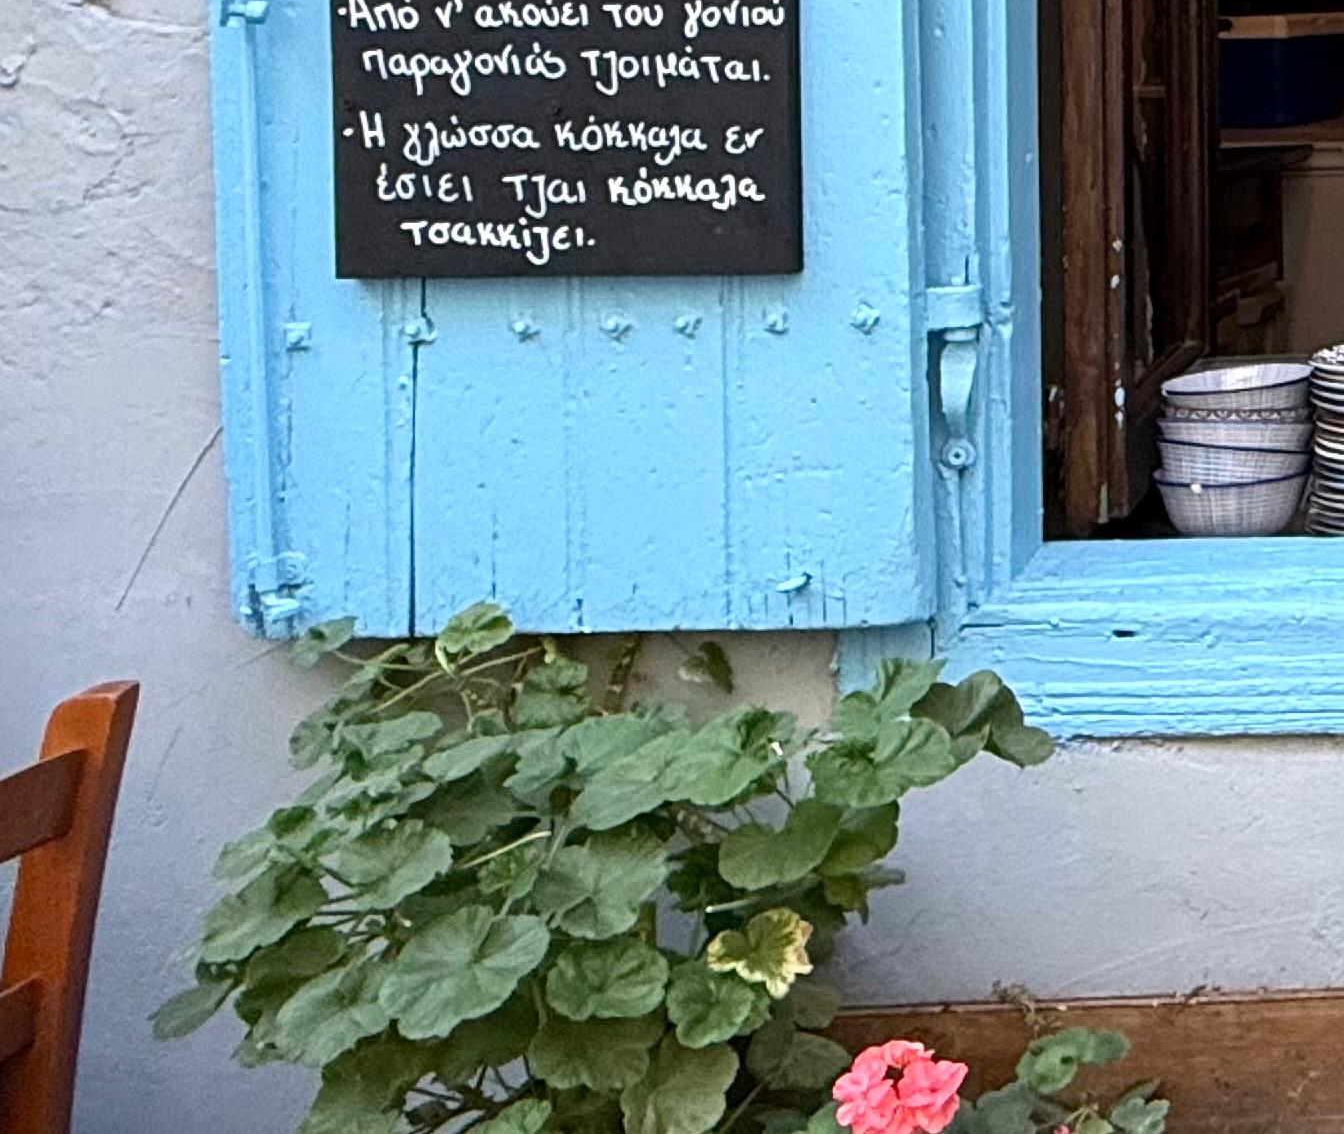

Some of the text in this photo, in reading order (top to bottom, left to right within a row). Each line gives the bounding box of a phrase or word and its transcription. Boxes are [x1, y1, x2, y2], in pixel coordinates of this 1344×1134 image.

[603, 5, 663, 27] του
[363, 43, 769, 95] παραγονιάς τζοιμάται.
[360, 111, 763, 165] Η γλώσσα κόκκαλα εν
[377, 163, 765, 218] έσιει τζαι κόκκαλα
[401, 217, 595, 265] τσακκίζει.
